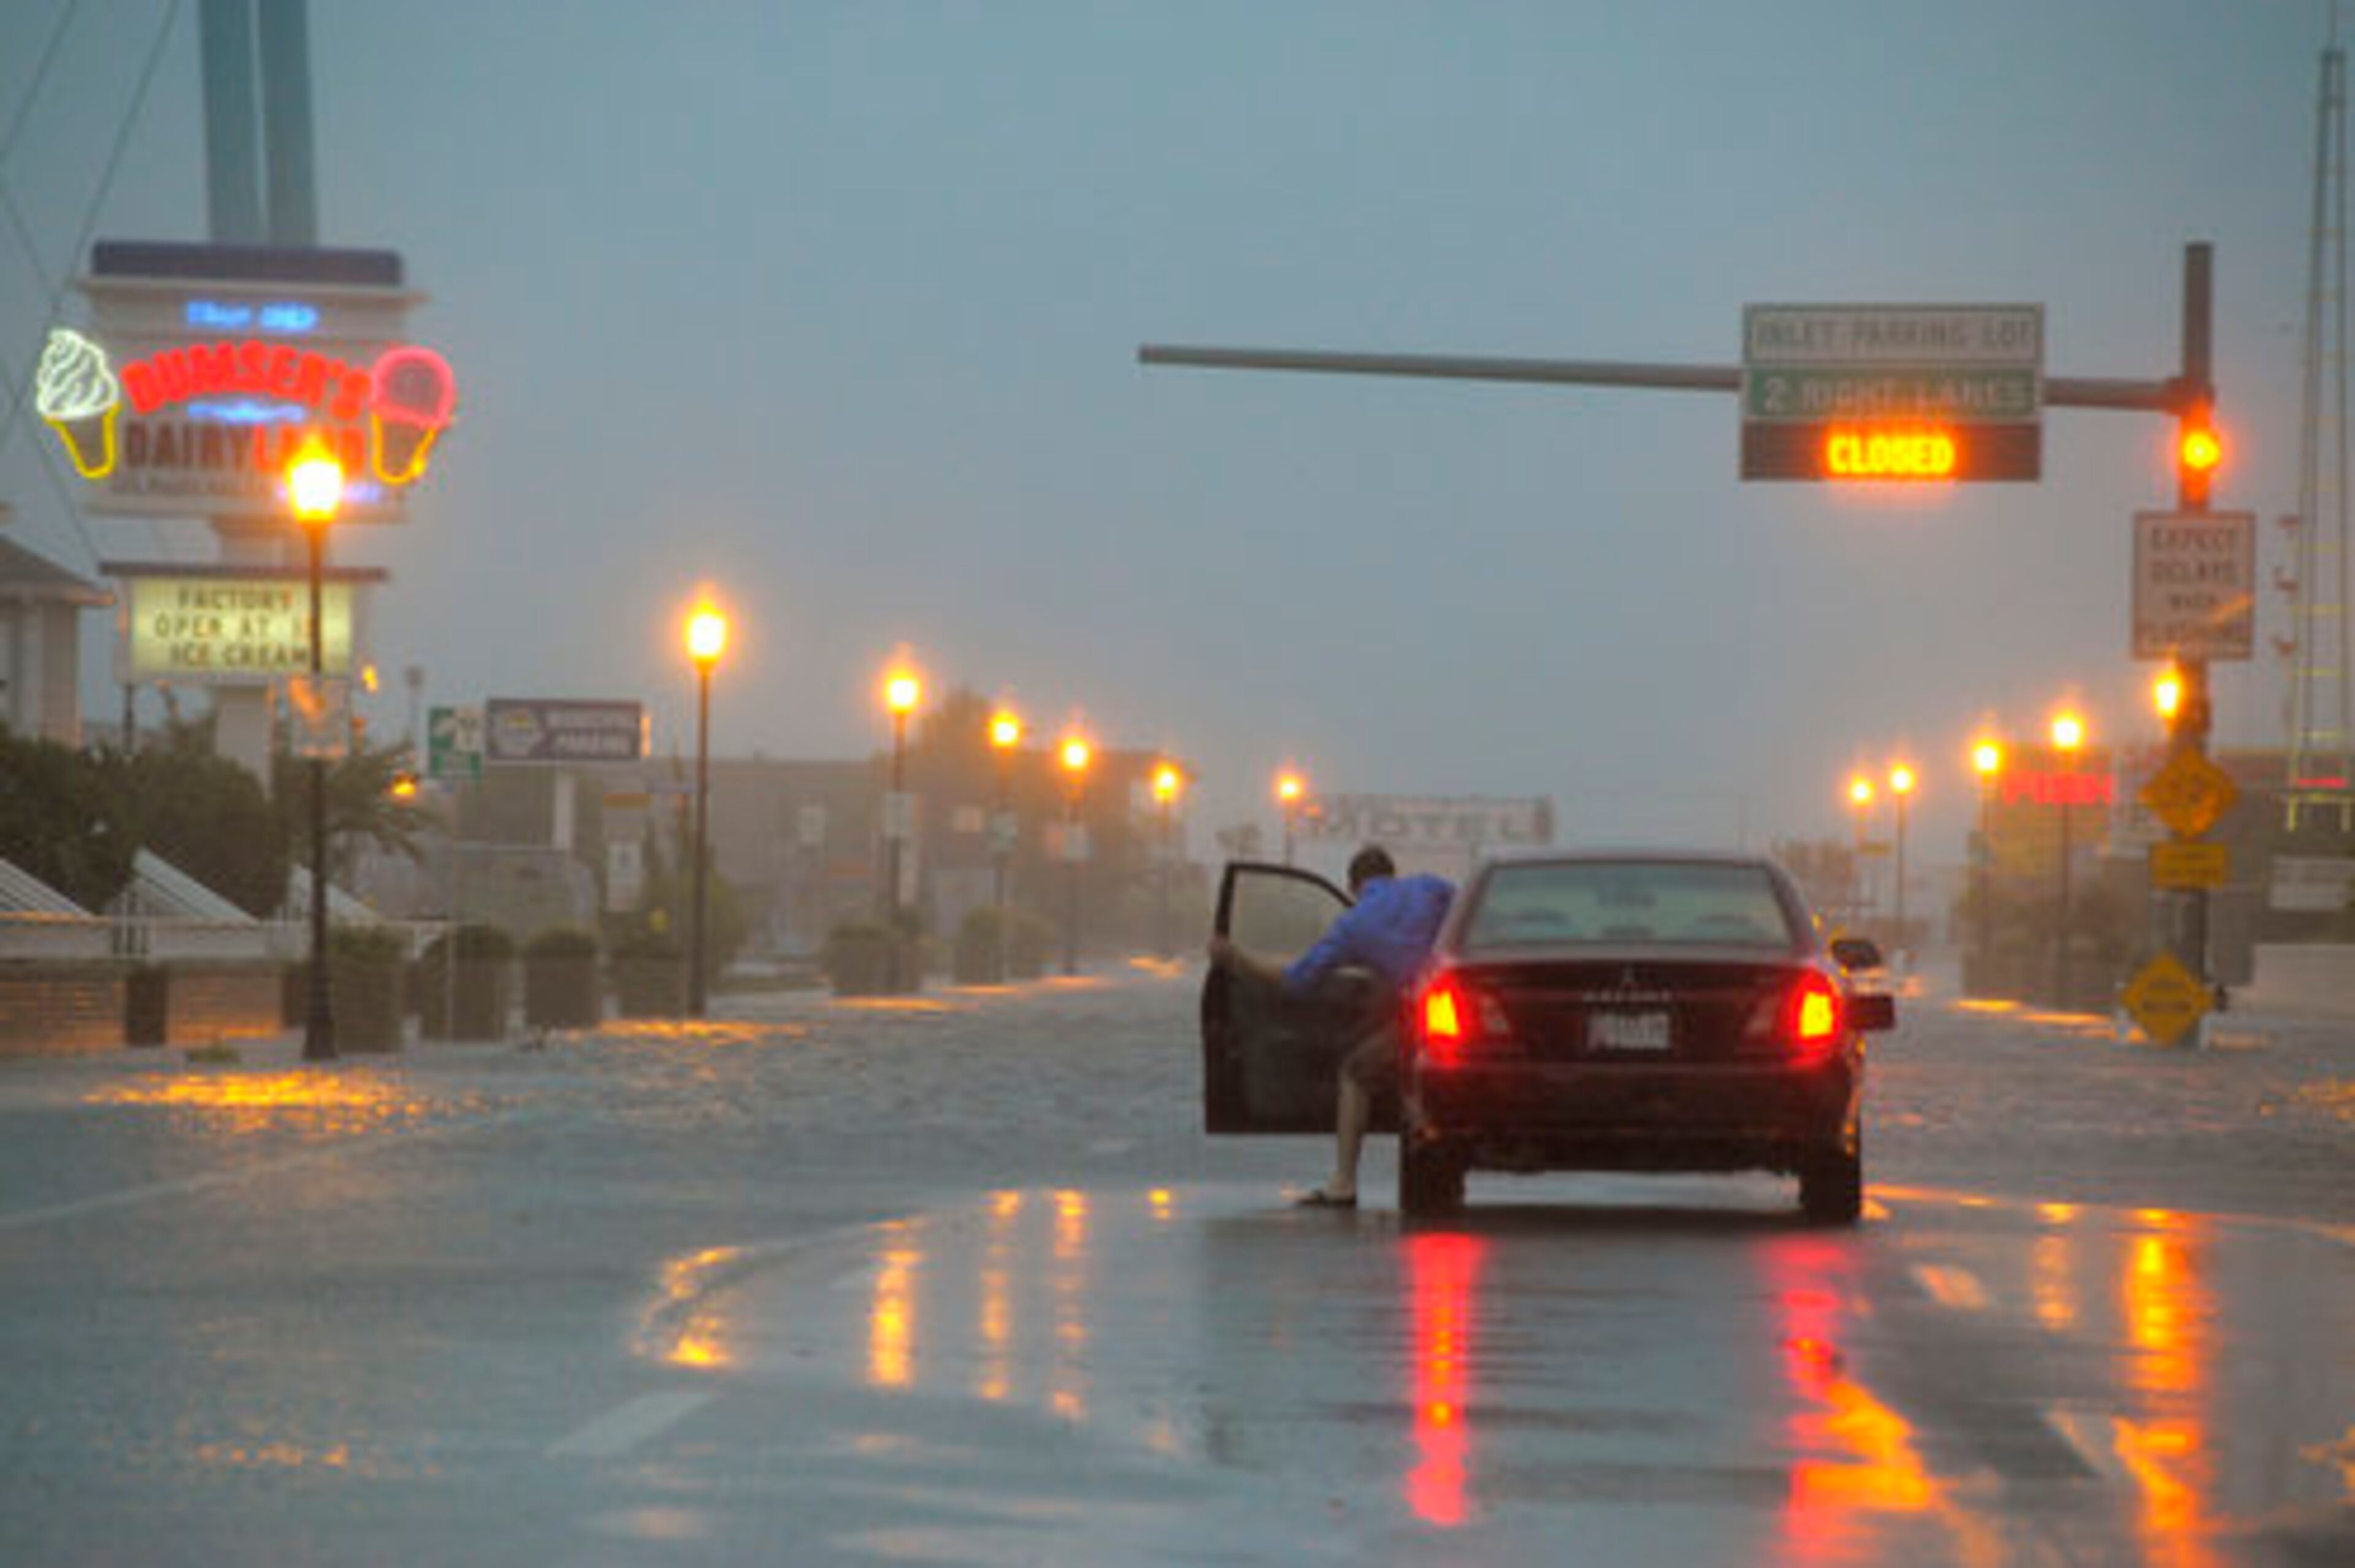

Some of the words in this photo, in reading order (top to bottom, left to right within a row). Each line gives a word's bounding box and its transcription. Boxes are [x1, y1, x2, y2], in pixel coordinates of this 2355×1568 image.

[1756, 316, 1834, 345] INLET
[1848, 316, 1966, 345] PARKING
[1978, 316, 2033, 345] LOT
[122, 339, 372, 421] DUMSER'S
[1762, 377, 1787, 412] 2
[1802, 377, 1896, 411] RIGHT
[1915, 377, 2028, 411] LANES
[125, 422, 366, 473] DAIRYLAD
[1826, 433, 1956, 475] CLOSED
[178, 587, 294, 611] FACTORY
[153, 613, 223, 638] OPEN
[239, 613, 270, 638] AT
[169, 642, 210, 667] ICE
[223, 642, 309, 667] CREAM
[1320, 808, 1533, 841] MOTEL
